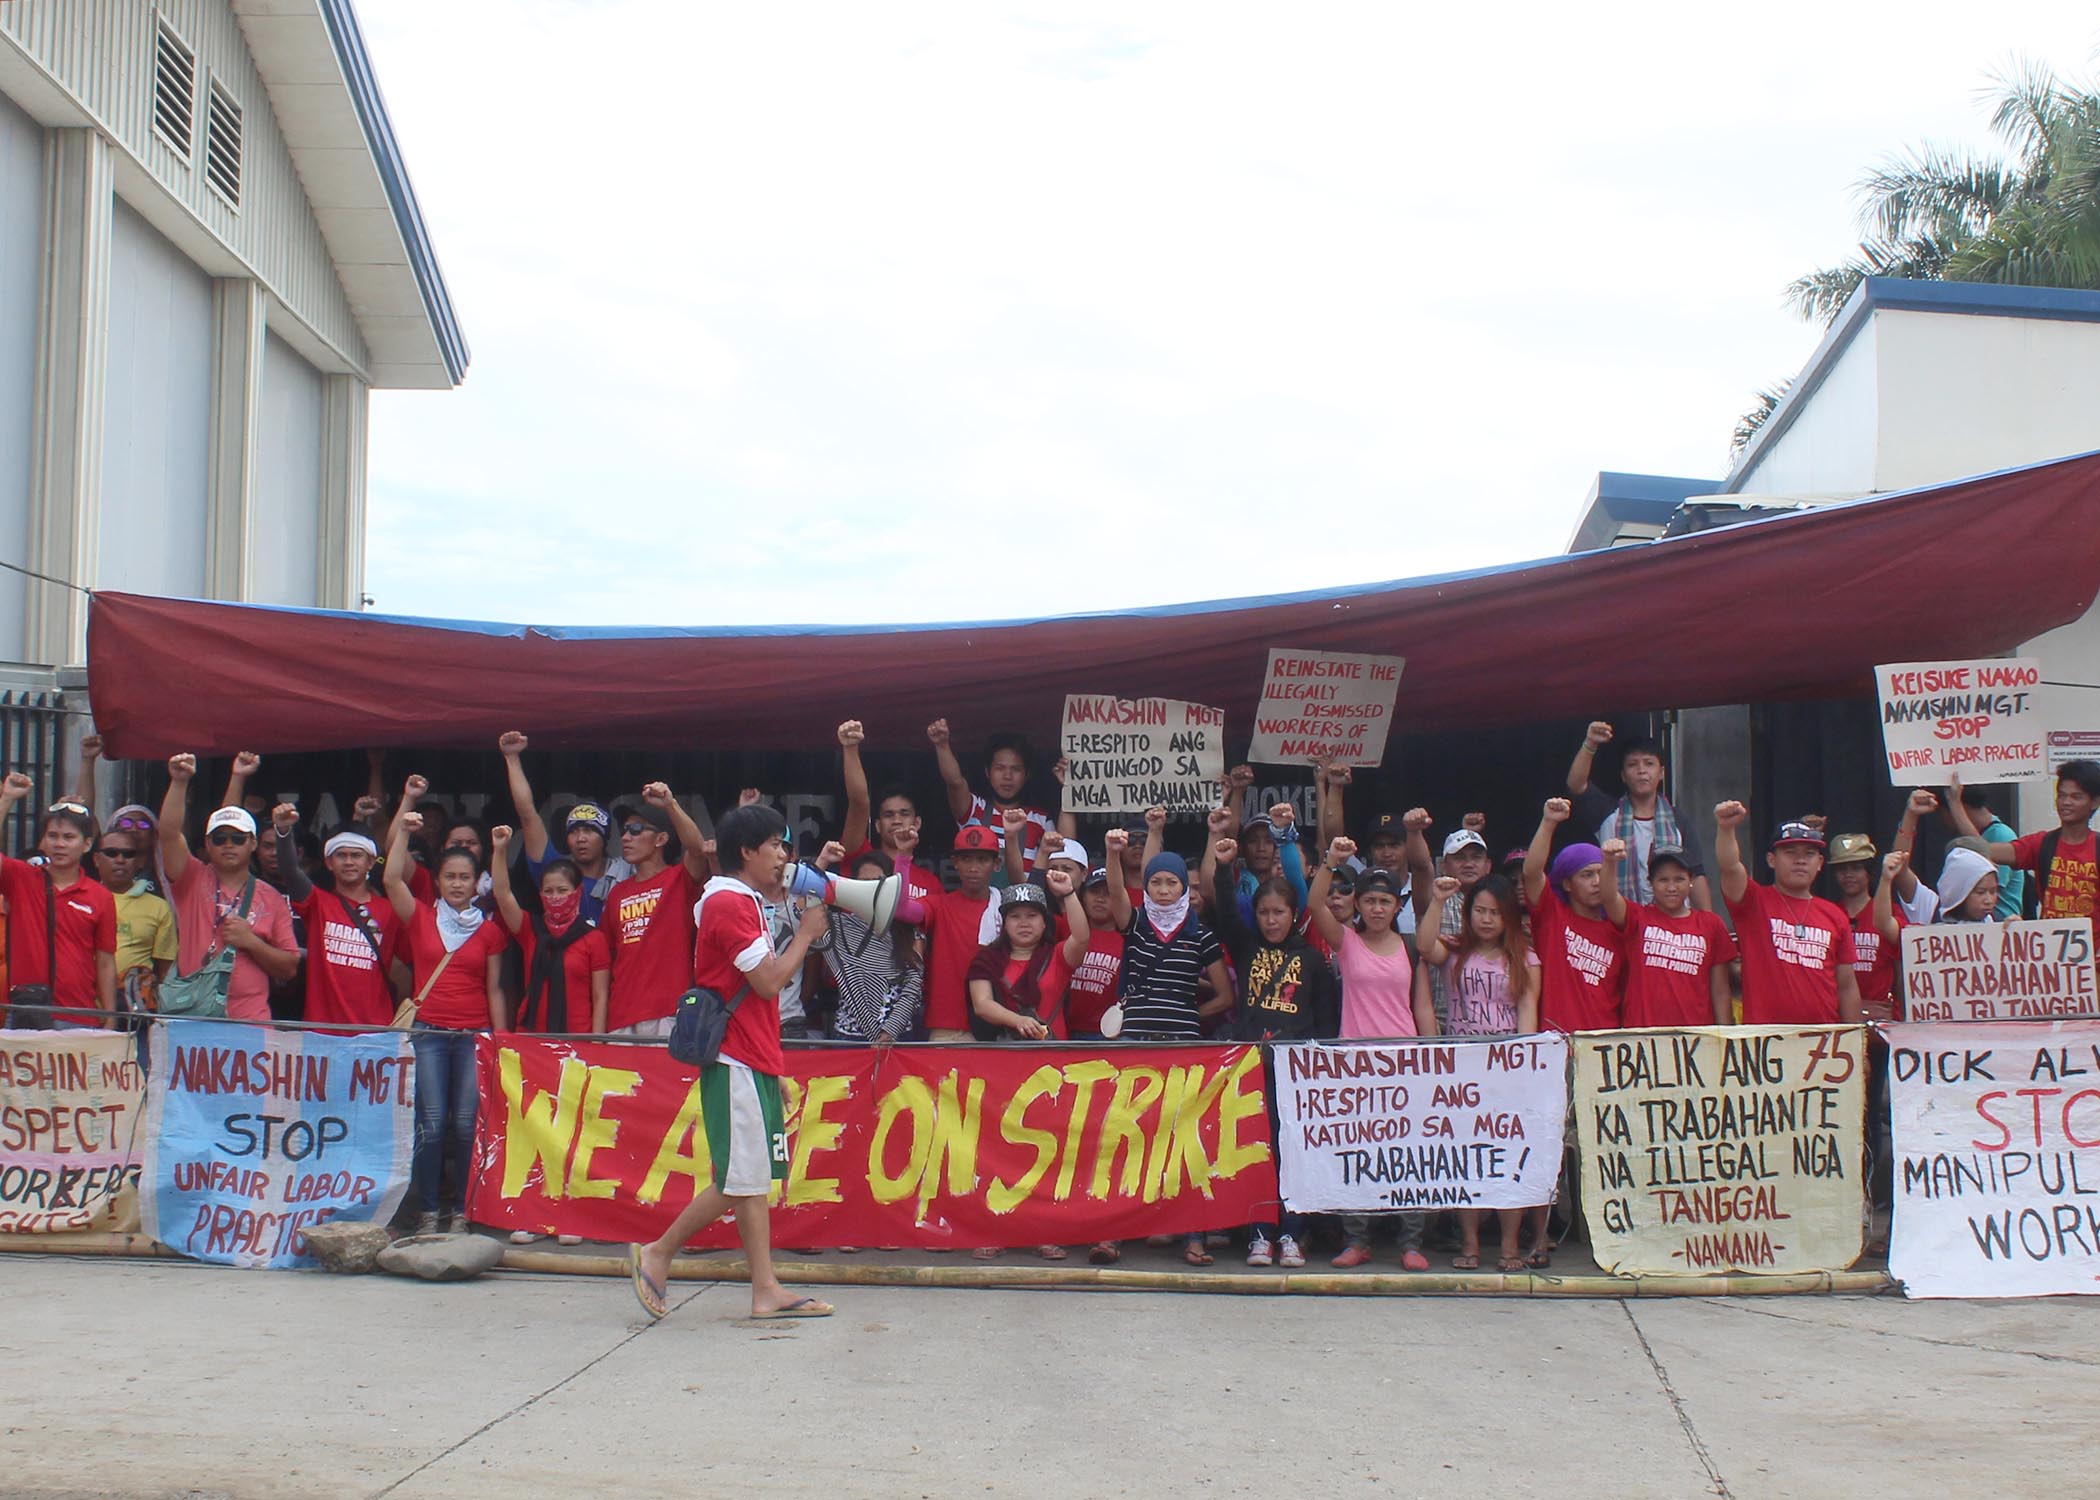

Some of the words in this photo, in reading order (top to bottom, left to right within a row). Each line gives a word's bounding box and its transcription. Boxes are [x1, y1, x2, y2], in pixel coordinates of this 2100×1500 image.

[1273, 658, 1362, 679] REINSTATE
[1369, 663, 1397, 681] THE
[1890, 668, 1970, 696] KEISUKE
[1977, 667, 2039, 687] NAKAO
[1264, 683, 1340, 700] ILLEGALLY
[1067, 698, 1167, 726] NAKASHIN
[1185, 703, 1223, 727] MGT.
[1303, 703, 1384, 718] DISMISSED
[1884, 694, 1971, 724] NAKASHIN
[1975, 693, 2029, 717] MGT.
[1067, 733, 1150, 754] I-RESPITO
[1169, 730, 1206, 753] ANG
[1257, 718, 1344, 737] WORKERS
[1348, 724, 1369, 739] OF
[1933, 715, 1990, 740] STOP
[1279, 739, 1364, 757] NAKASHIN
[1888, 748, 1935, 770] UNFAIR
[1941, 748, 1983, 765] LABOR
[1984, 742, 2040, 763] PRACTICE
[1070, 755, 1164, 781] KATUNGOD
[1174, 754, 1201, 777] SA
[1071, 783, 1112, 808] MGA
[1117, 778, 1222, 807] TRABAHANTE
[2000, 931, 2046, 962] ANG
[2052, 929, 2090, 963] 75
[1909, 970, 1936, 999] KA
[1939, 961, 2095, 997] TRABAHANTE
[169, 1046, 328, 1102] NAKASHIN
[350, 1057, 416, 1108] MGT.
[1288, 1046, 1456, 1082] NAKASHIN
[1486, 1042, 1547, 1072] MGT.
[1593, 1036, 1705, 1093] IBALIK
[1720, 1034, 1784, 1088] ANG
[1798, 1029, 1855, 1084] 75
[1893, 1048, 1996, 1084] DICK
[1431, 1082, 1481, 1108] ANG
[1303, 1117, 1411, 1150] KATUNGOD
[1422, 1115, 1455, 1139] SA
[1473, 1112, 1525, 1141] MGA
[1595, 1104, 1632, 1146] KA
[1638, 1086, 1840, 1143] TRABAHANTE
[215, 1113, 348, 1162] STOP
[498, 1047, 644, 1202] WE
[867, 1068, 985, 1228] ON
[986, 1046, 1270, 1215] STRIKE
[1597, 1151, 1635, 1190] NA
[1645, 1141, 1779, 1187] ILLEGAL
[1793, 1134, 1844, 1179] NGA
[1903, 1150, 2098, 1199] MANIPUL
[174, 1162, 270, 1201] UNFAIR
[283, 1171, 376, 1204] LABOR
[1603, 1198, 1634, 1234] GI
[1648, 1185, 1791, 1225] TANGGAL
